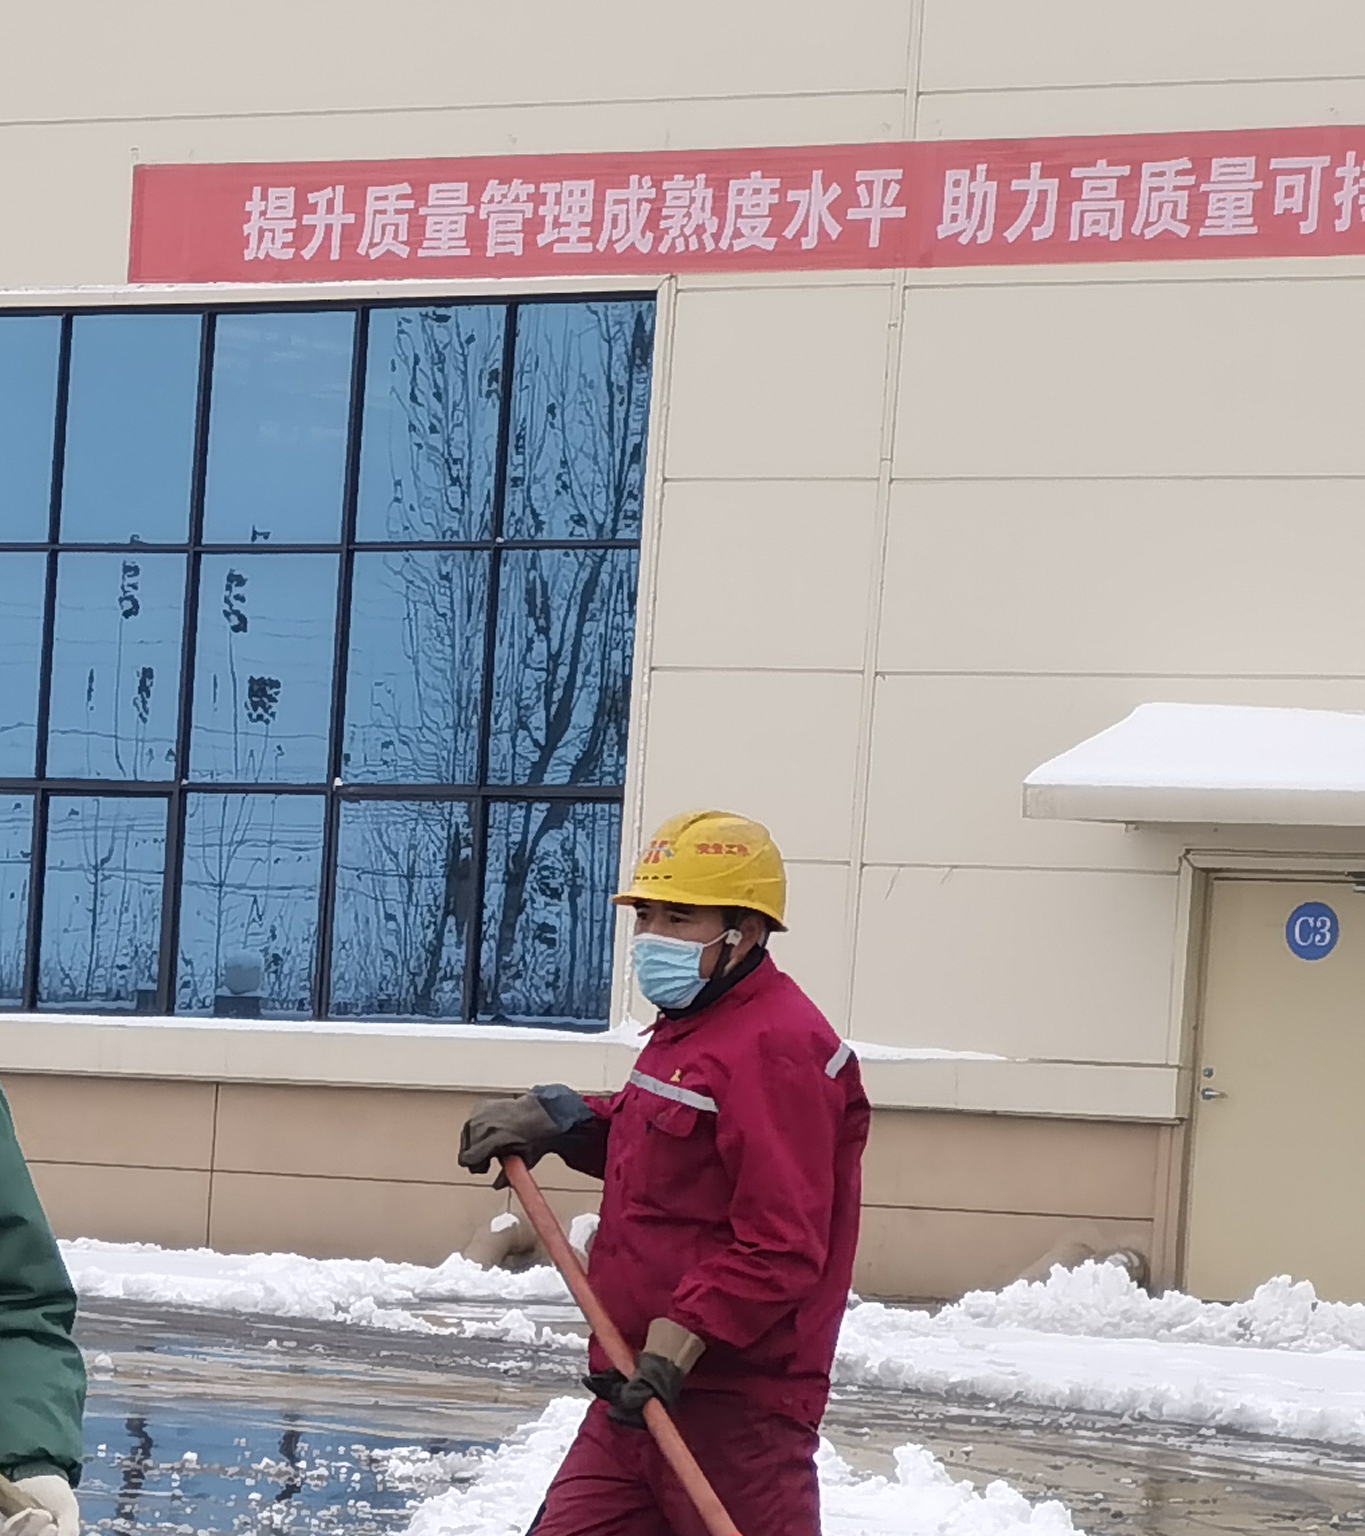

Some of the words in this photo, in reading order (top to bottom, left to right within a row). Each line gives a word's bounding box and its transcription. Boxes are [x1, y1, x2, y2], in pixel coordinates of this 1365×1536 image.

[243, 168, 906, 260] 提升质量管理成熟度水平
[1294, 916, 1331, 946] C3
